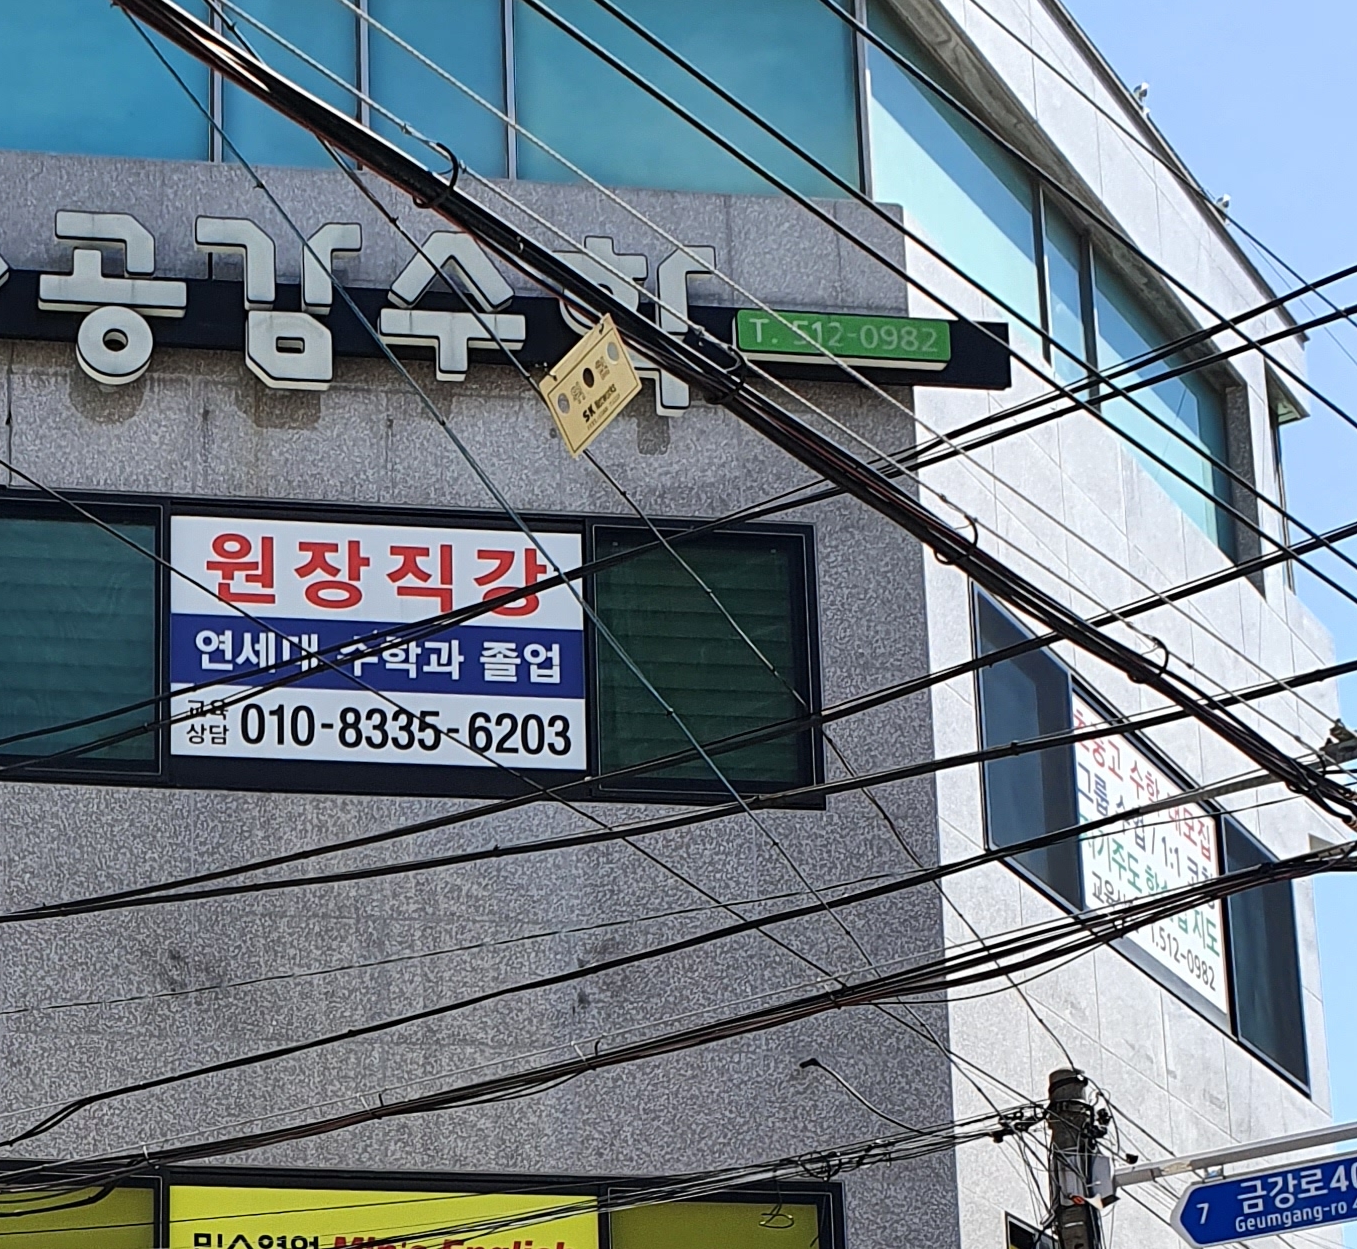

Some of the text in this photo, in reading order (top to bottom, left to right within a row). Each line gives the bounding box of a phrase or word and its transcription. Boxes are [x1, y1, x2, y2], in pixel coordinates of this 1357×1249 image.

[791, 317, 940, 354] 512-0982
[206, 532, 548, 618] 원장직강
[195, 629, 561, 684] 연세대 수학과 졸업
[186, 723, 230, 745] 상담
[240, 702, 572, 757] 010-8335-6203
[1077, 762, 1109, 817] 그룹
[1161, 836, 1181, 878] 1:1
[1193, 909, 1220, 958] 지도
[1196, 1203, 1209, 1224] 7
[1235, 1201, 1348, 1233] Geumgang-ro
